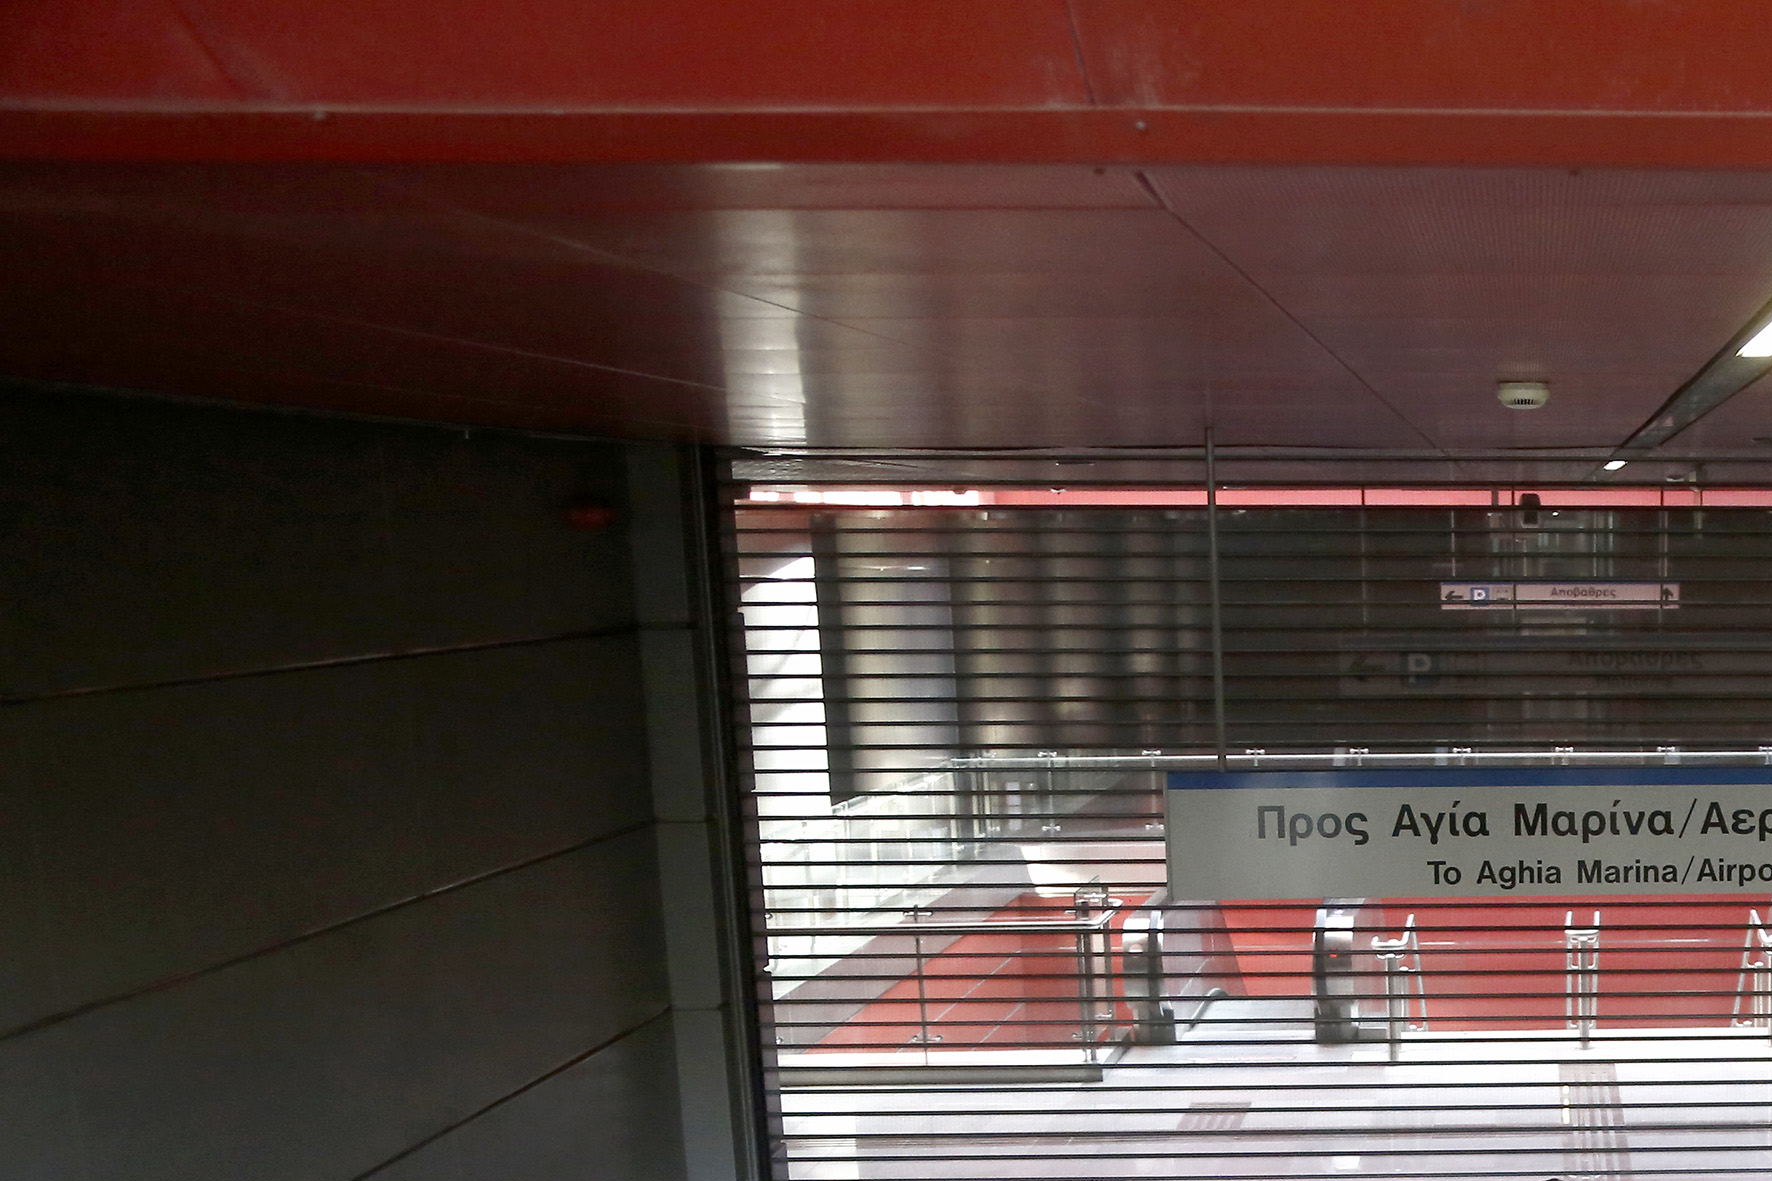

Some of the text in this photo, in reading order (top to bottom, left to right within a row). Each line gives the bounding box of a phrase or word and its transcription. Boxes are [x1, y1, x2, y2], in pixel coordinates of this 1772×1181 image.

[1257, 804, 1370, 847] Προς
[1392, 800, 1490, 845] Αγία
[1426, 860, 1462, 885] To
[1476, 859, 1562, 890] Aghia
